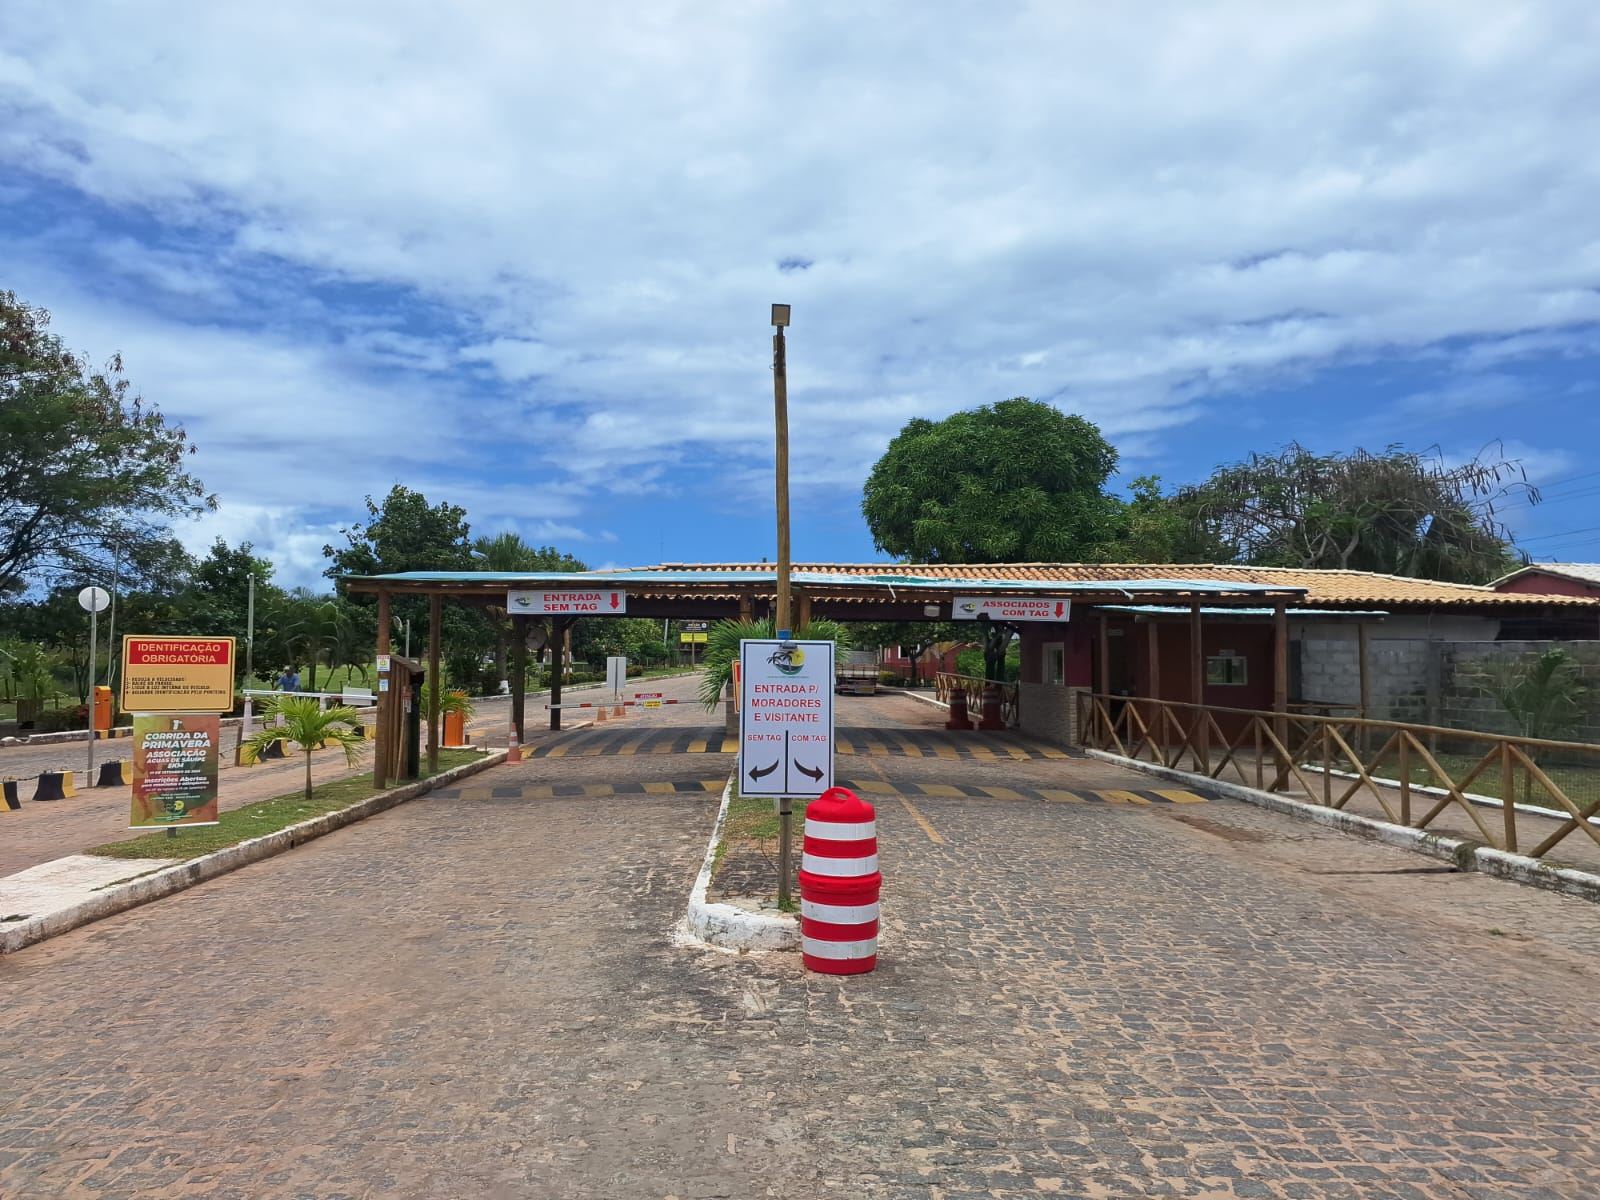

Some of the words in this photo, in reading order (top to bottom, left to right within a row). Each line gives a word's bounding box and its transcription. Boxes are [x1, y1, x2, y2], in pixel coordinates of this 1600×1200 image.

[543, 593, 602, 602] ENTRADA
[543, 603, 569, 611] SEM
[573, 603, 598, 611] TAG
[983, 600, 1050, 609] ASSOCIADOS
[138, 643, 221, 653] IDENTIFICAÇÃO
[141, 654, 216, 663] OBRIGATÓRIA
[754, 684, 806, 693] ENTRADA
[808, 685, 819, 693] P/
[751, 699, 821, 708] MORADORES
[754, 712, 761, 721] E
[764, 713, 819, 722] VISITANTE
[145, 732, 191, 740] CORRIDA
[193, 731, 208, 739] DA
[142, 739, 211, 749] PRIMAVERA
[146, 749, 207, 758] ASSOCIAÇÃO
